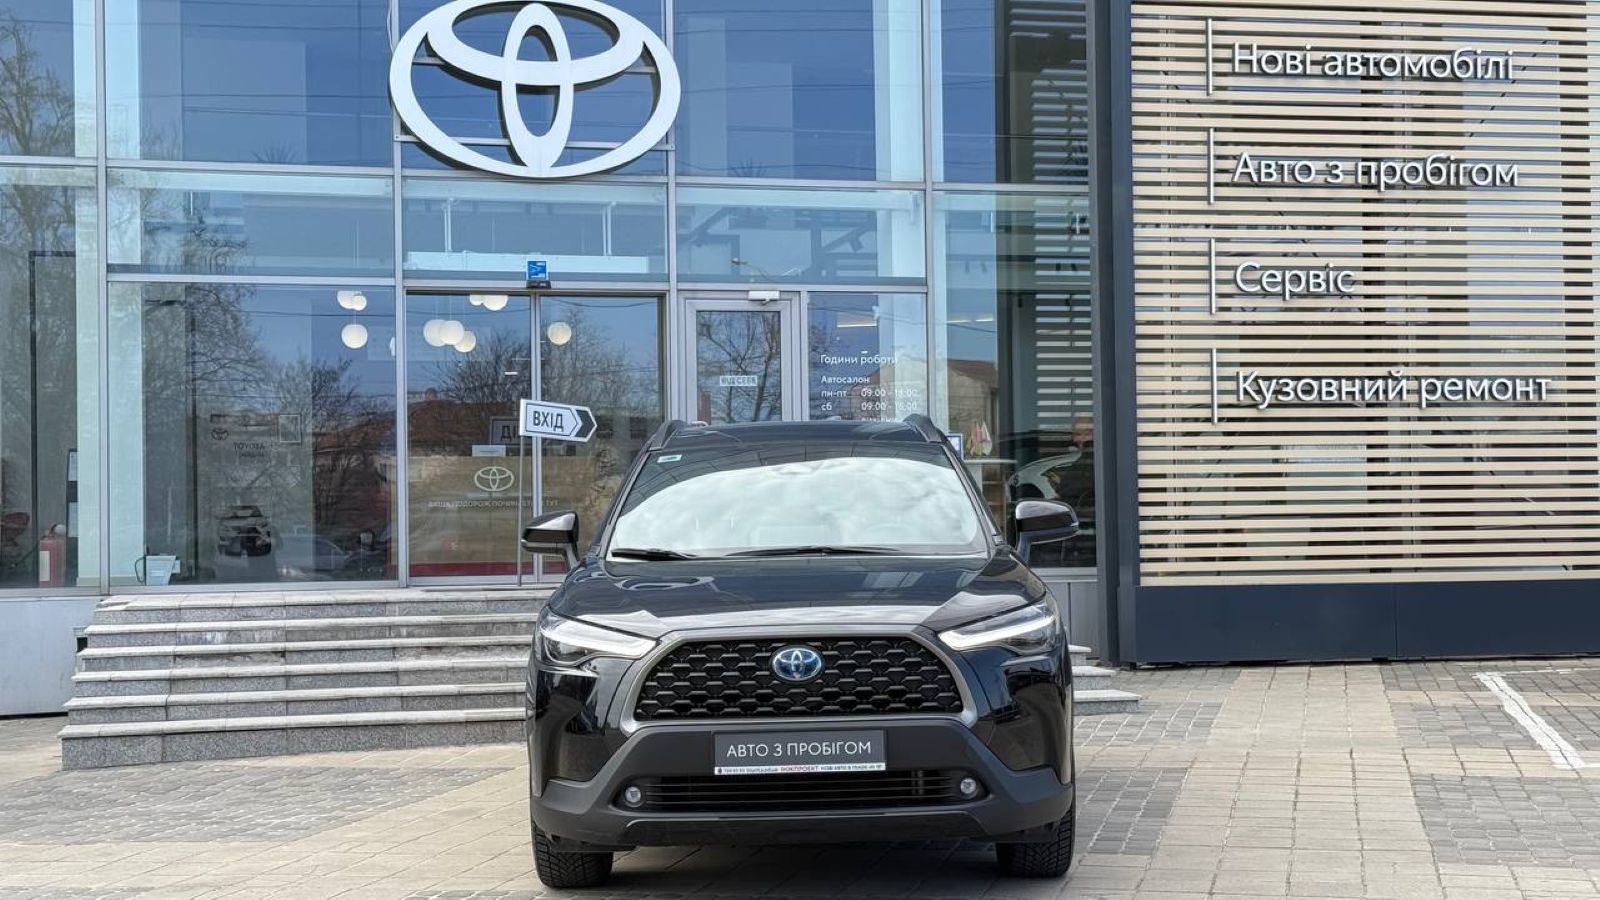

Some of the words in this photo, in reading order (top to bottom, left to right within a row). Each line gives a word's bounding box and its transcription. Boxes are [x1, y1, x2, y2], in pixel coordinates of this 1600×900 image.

[1233, 42, 1312, 76] Нові
[1324, 48, 1515, 80] автомобілі
[1233, 152, 1315, 185] Авто
[1326, 160, 1344, 185] з
[1357, 152, 1520, 191] пробігом
[1235, 262, 1356, 300] Сервіс
[820, 354, 858, 365] Години
[860, 354, 898, 366] роботи
[821, 375, 871, 384] Автосалон
[1237, 369, 1408, 409] Кузовний
[1421, 378, 1552, 409] ремонт
[821, 389, 848, 397] пн-пт
[821, 401, 833, 411] сб
[533, 410, 564, 431] ВХІД
[727, 744, 768, 758] АВТО
[787, 740, 871, 756] ПРОБІГОМ
